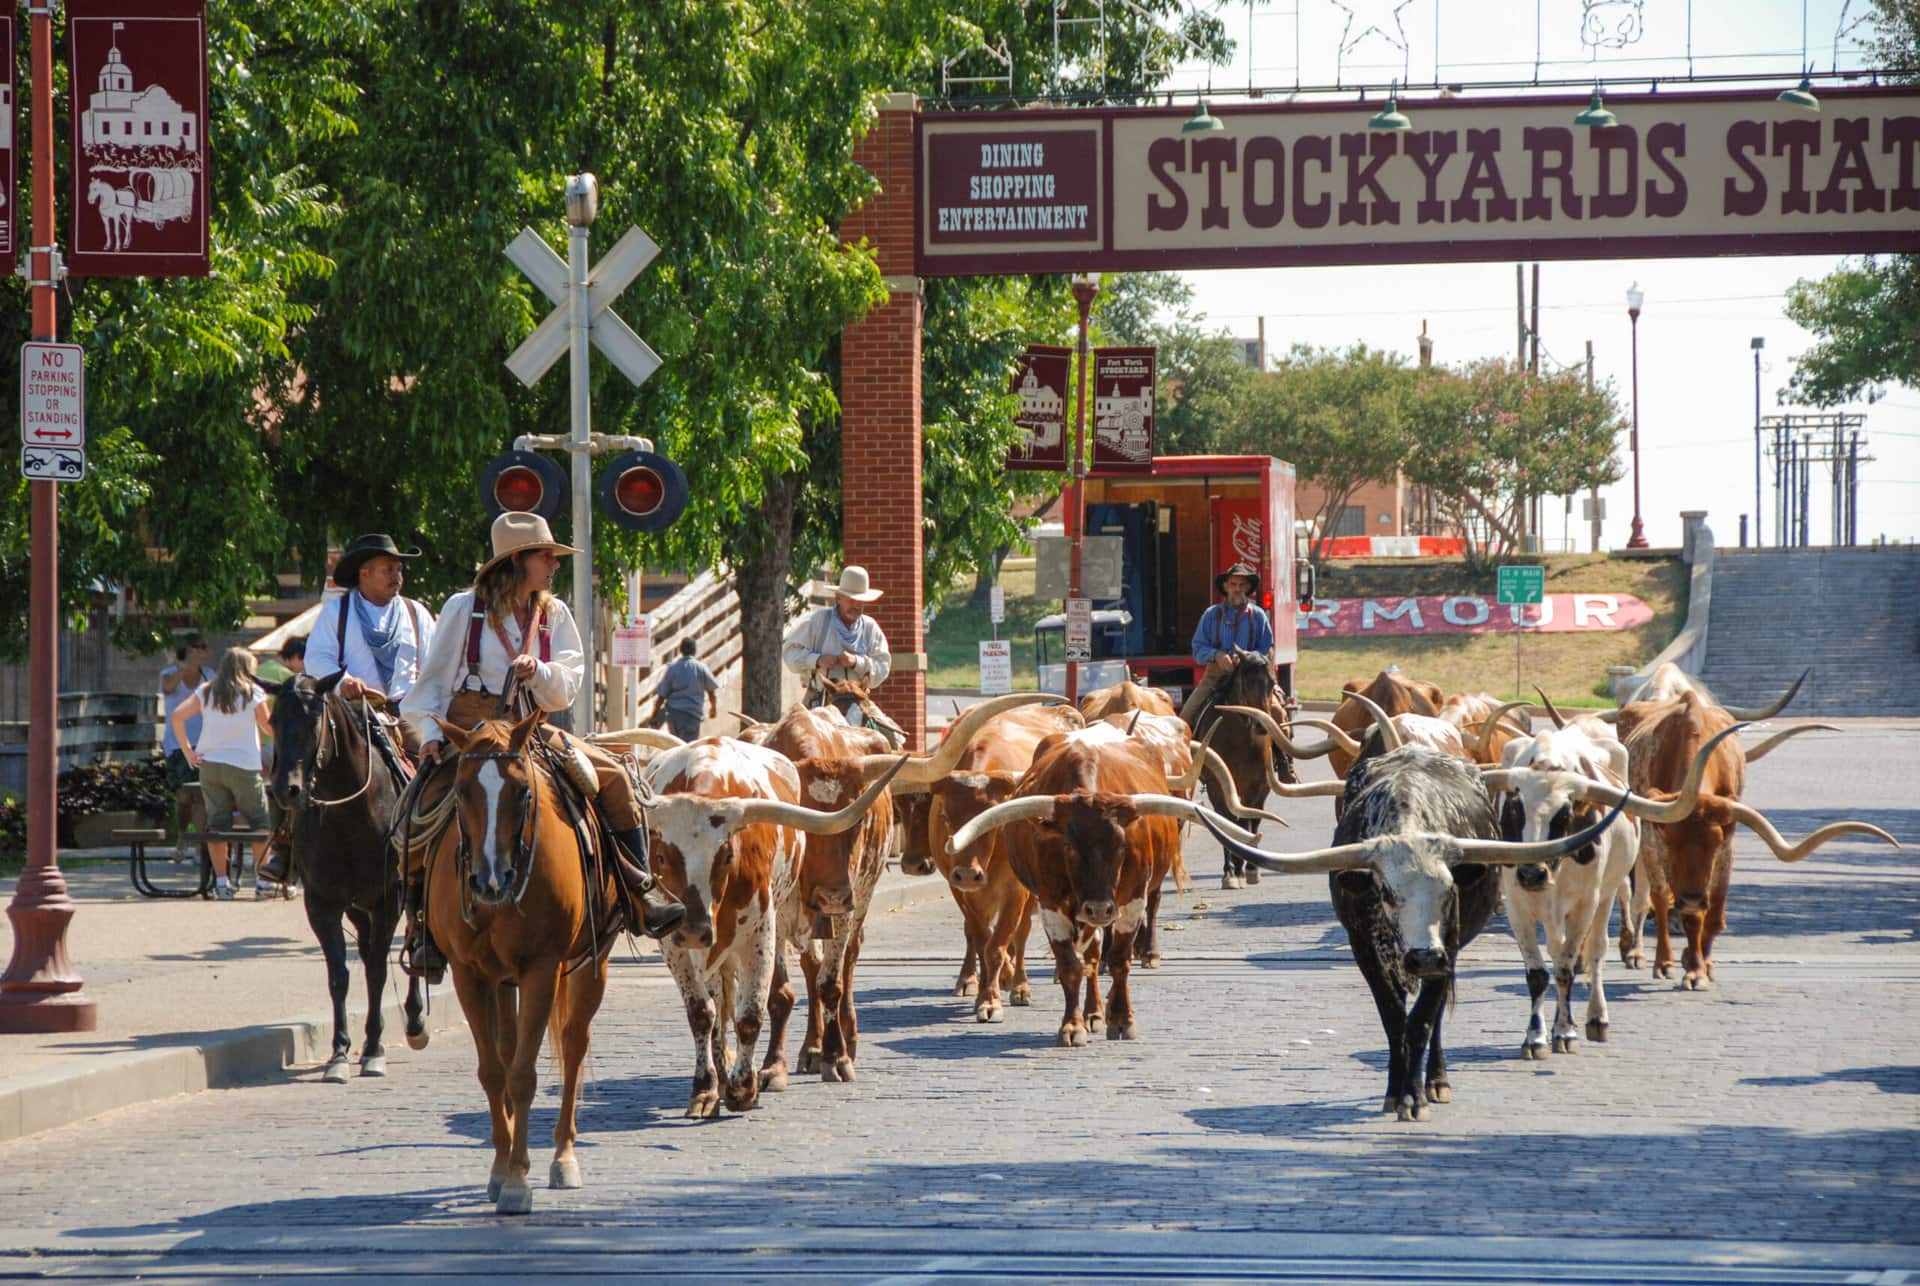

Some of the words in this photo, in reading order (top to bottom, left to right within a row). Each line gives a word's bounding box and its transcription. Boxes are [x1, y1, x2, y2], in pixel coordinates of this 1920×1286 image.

[981, 143, 1044, 168] DINING
[1147, 122, 1688, 231] STOCKYARDS
[1724, 116, 1920, 217] STAT
[970, 174, 1055, 200] SHOPPING
[938, 205, 1088, 231] ENTERTAINMENT
[42, 352, 63, 367] NO
[31, 370, 74, 383] PARKING
[28, 384, 77, 397] STOPPING
[46, 398, 59, 409] OR
[27, 411, 78, 424] STANDING
[1296, 594, 1618, 628] RMOUR
